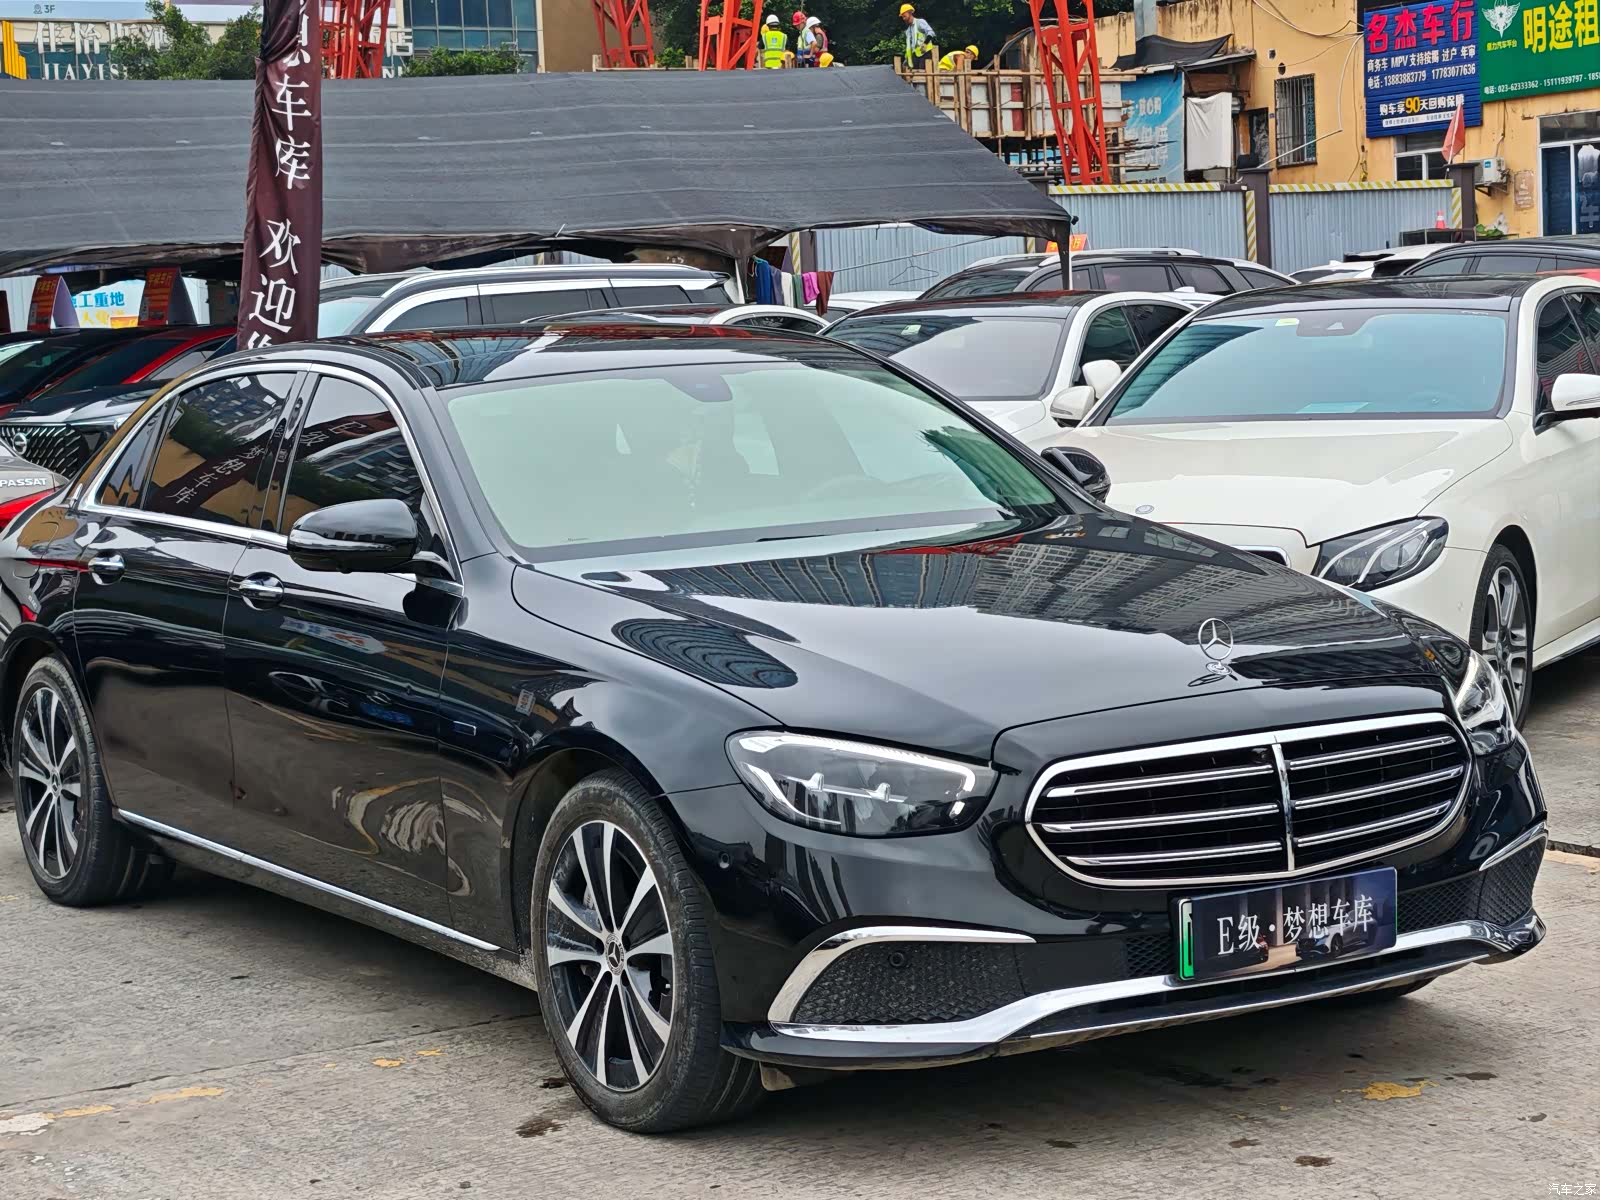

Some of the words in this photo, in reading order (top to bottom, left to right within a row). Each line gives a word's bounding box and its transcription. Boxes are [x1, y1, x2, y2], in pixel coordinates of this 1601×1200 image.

[44, 5, 55, 13] 3F
[1367, 0, 1475, 54] 名杰车行
[1523, 0, 1600, 53] 明途租
[1367, 58, 1388, 72] 商务车
[1442, 47, 1457, 62] 过户
[1432, 63, 1476, 80] 17783077636
[0, 477, 48, 488] PASSAT
[1217, 894, 1374, 956] E级·梦想车库
